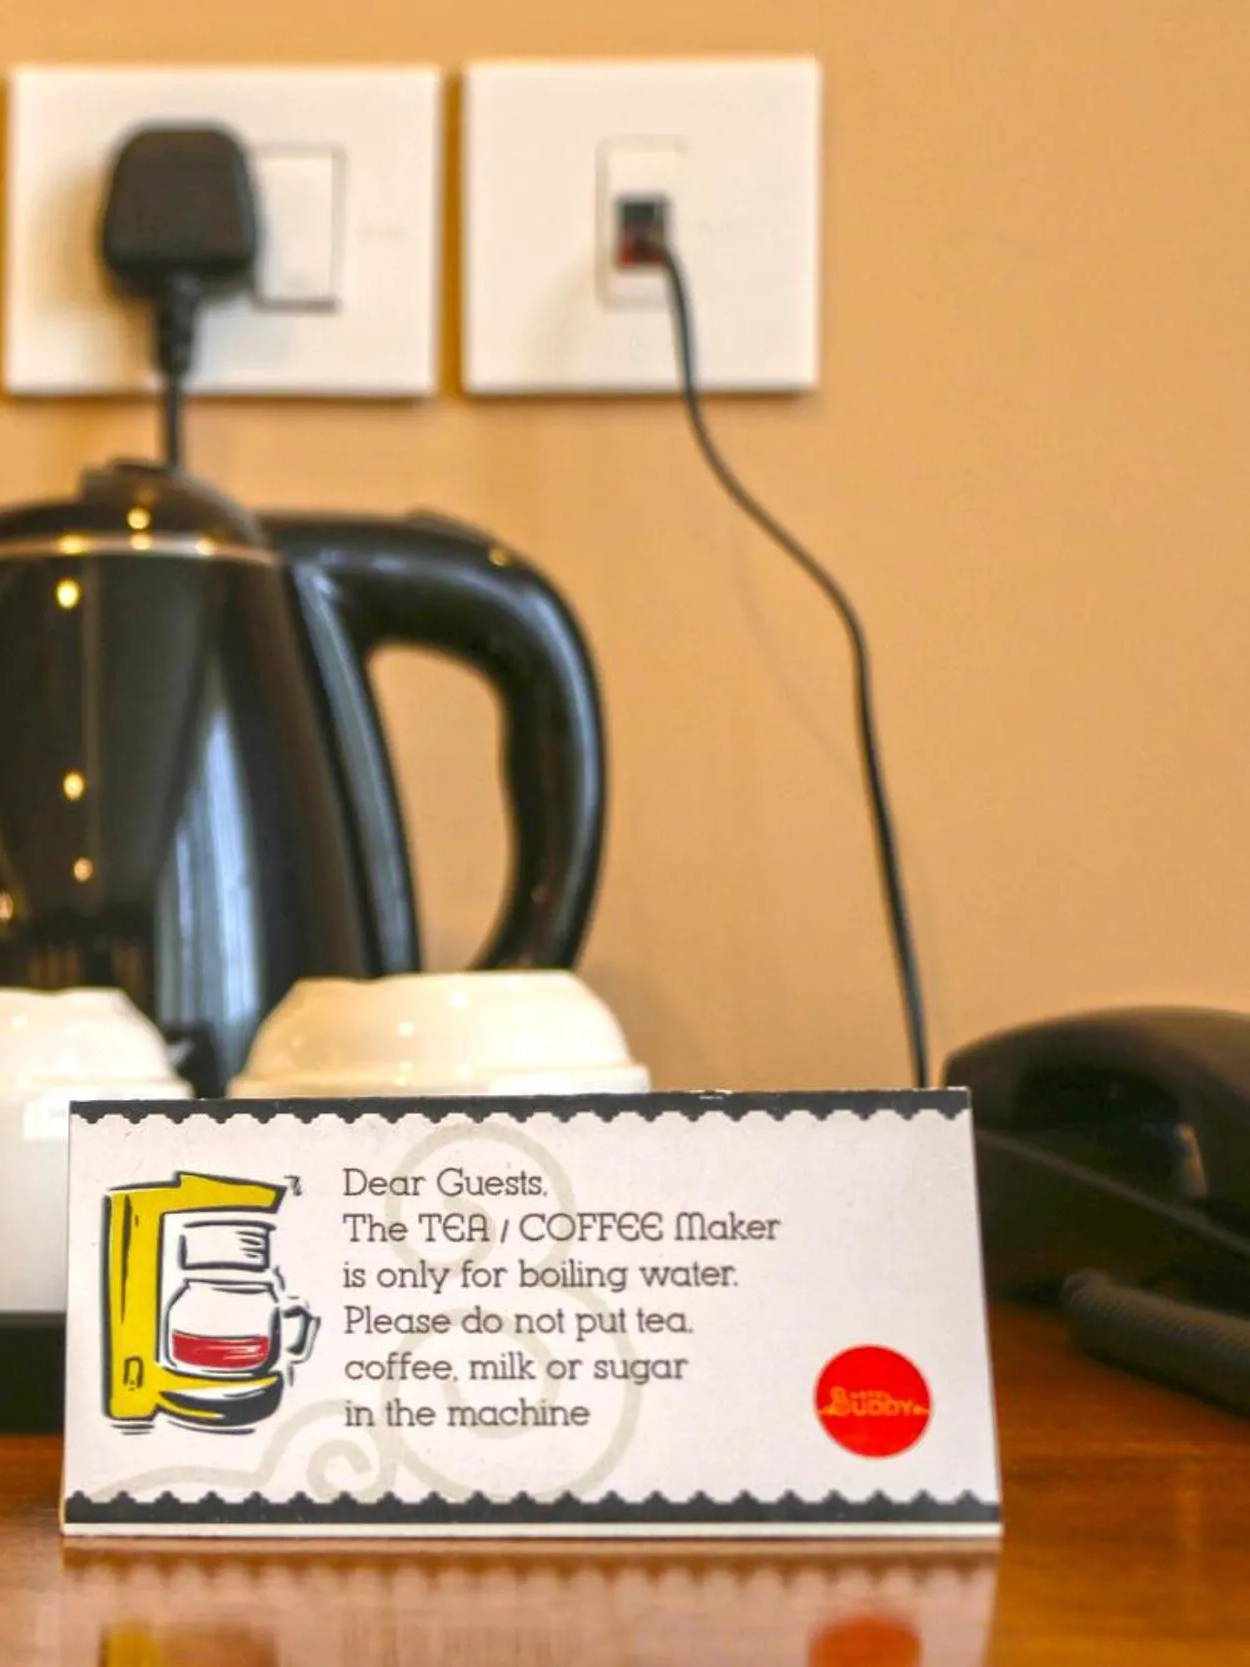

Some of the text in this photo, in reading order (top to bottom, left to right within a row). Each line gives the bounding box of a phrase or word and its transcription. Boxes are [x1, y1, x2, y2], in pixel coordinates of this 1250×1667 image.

[342, 1167, 427, 1197] Dear
[342, 1210, 782, 1244] The TEA / COFFEE Maker
[342, 1257, 740, 1295] is only for boiling water.
[344, 1304, 452, 1335] Please
[460, 1304, 504, 1335] do
[514, 1307, 565, 1335] not
[575, 1308, 627, 1343] put
[469, 1350, 537, 1381] milk
[545, 1357, 584, 1381] or
[593, 1356, 690, 1386] sugar
[344, 1397, 592, 1428] in the machine
